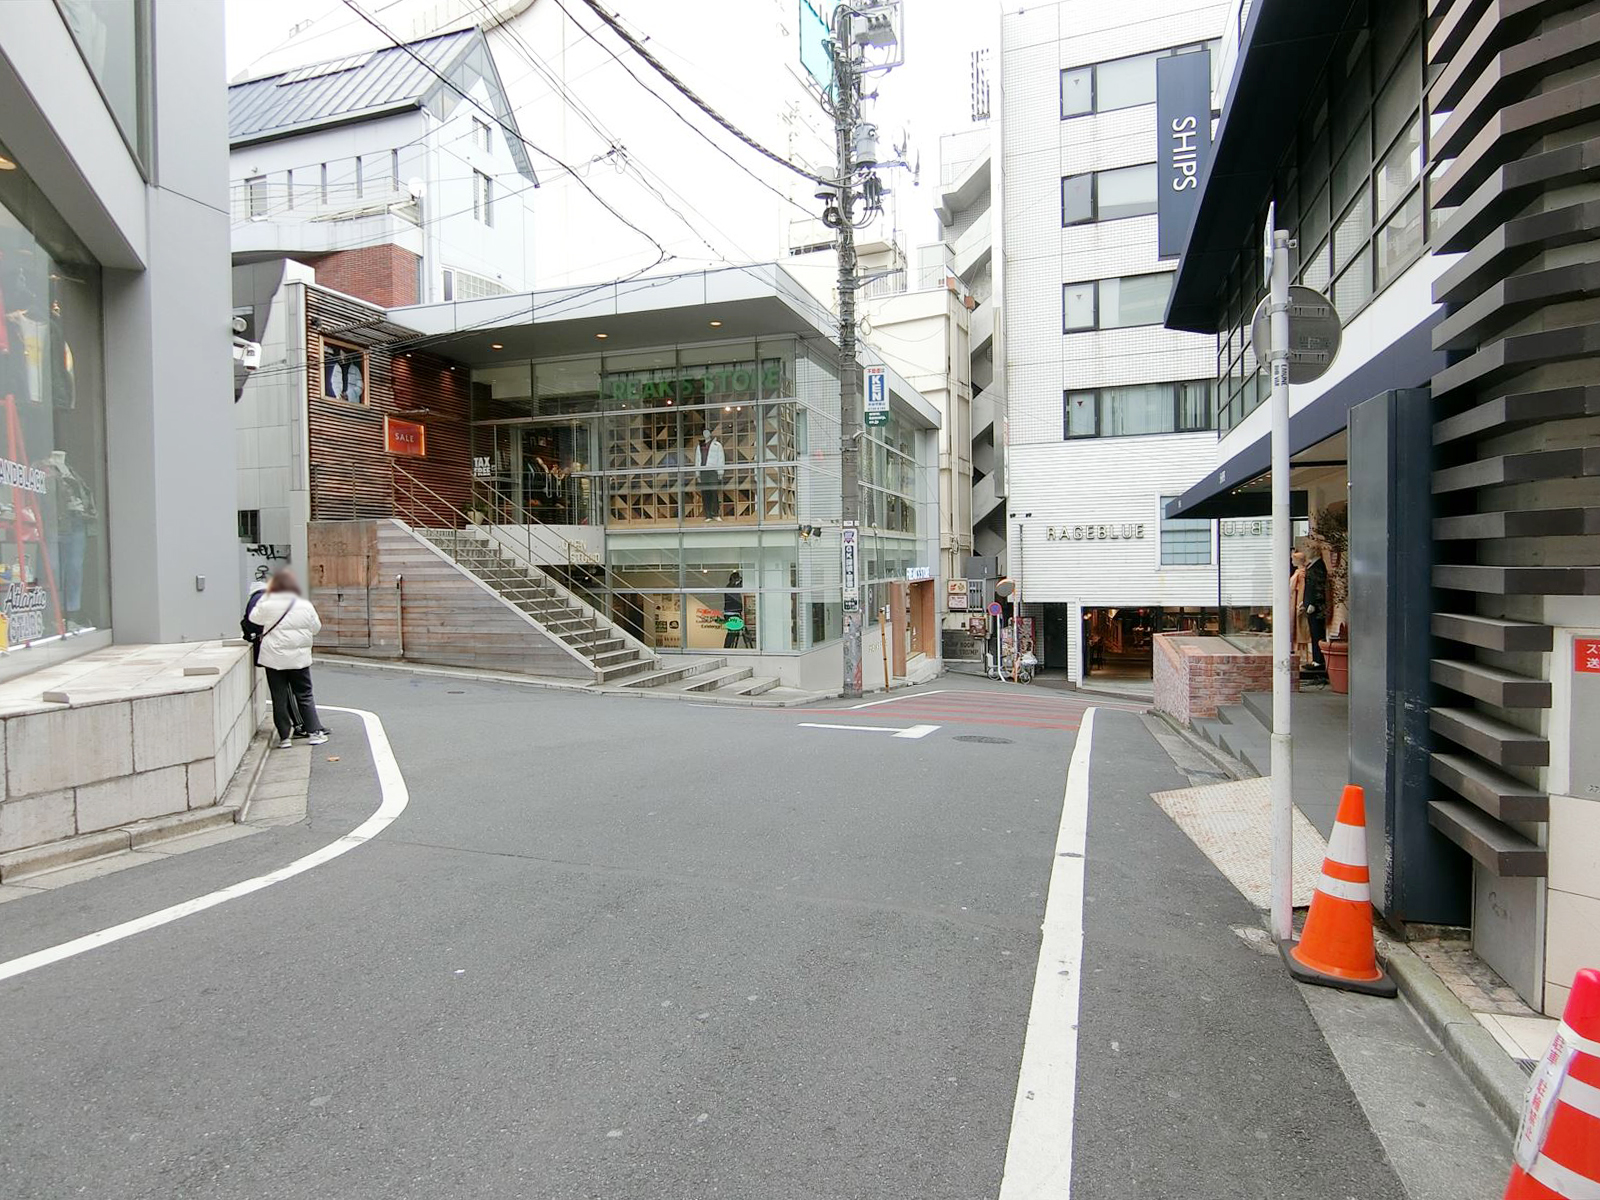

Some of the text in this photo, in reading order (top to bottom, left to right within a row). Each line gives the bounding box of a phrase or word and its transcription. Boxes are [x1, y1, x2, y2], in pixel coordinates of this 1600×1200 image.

[1172, 116, 1197, 191] SHIPS
[598, 365, 780, 398] FREAKS STORE
[871, 374, 882, 401] KEN
[394, 432, 415, 442] SALE
[473, 457, 491, 467] TAX
[473, 467, 491, 477] FREE
[1045, 524, 1145, 541] RAGEBLUE
[4, 581, 47, 613] Atlantic
[1586, 644, 1600, 654] ス
